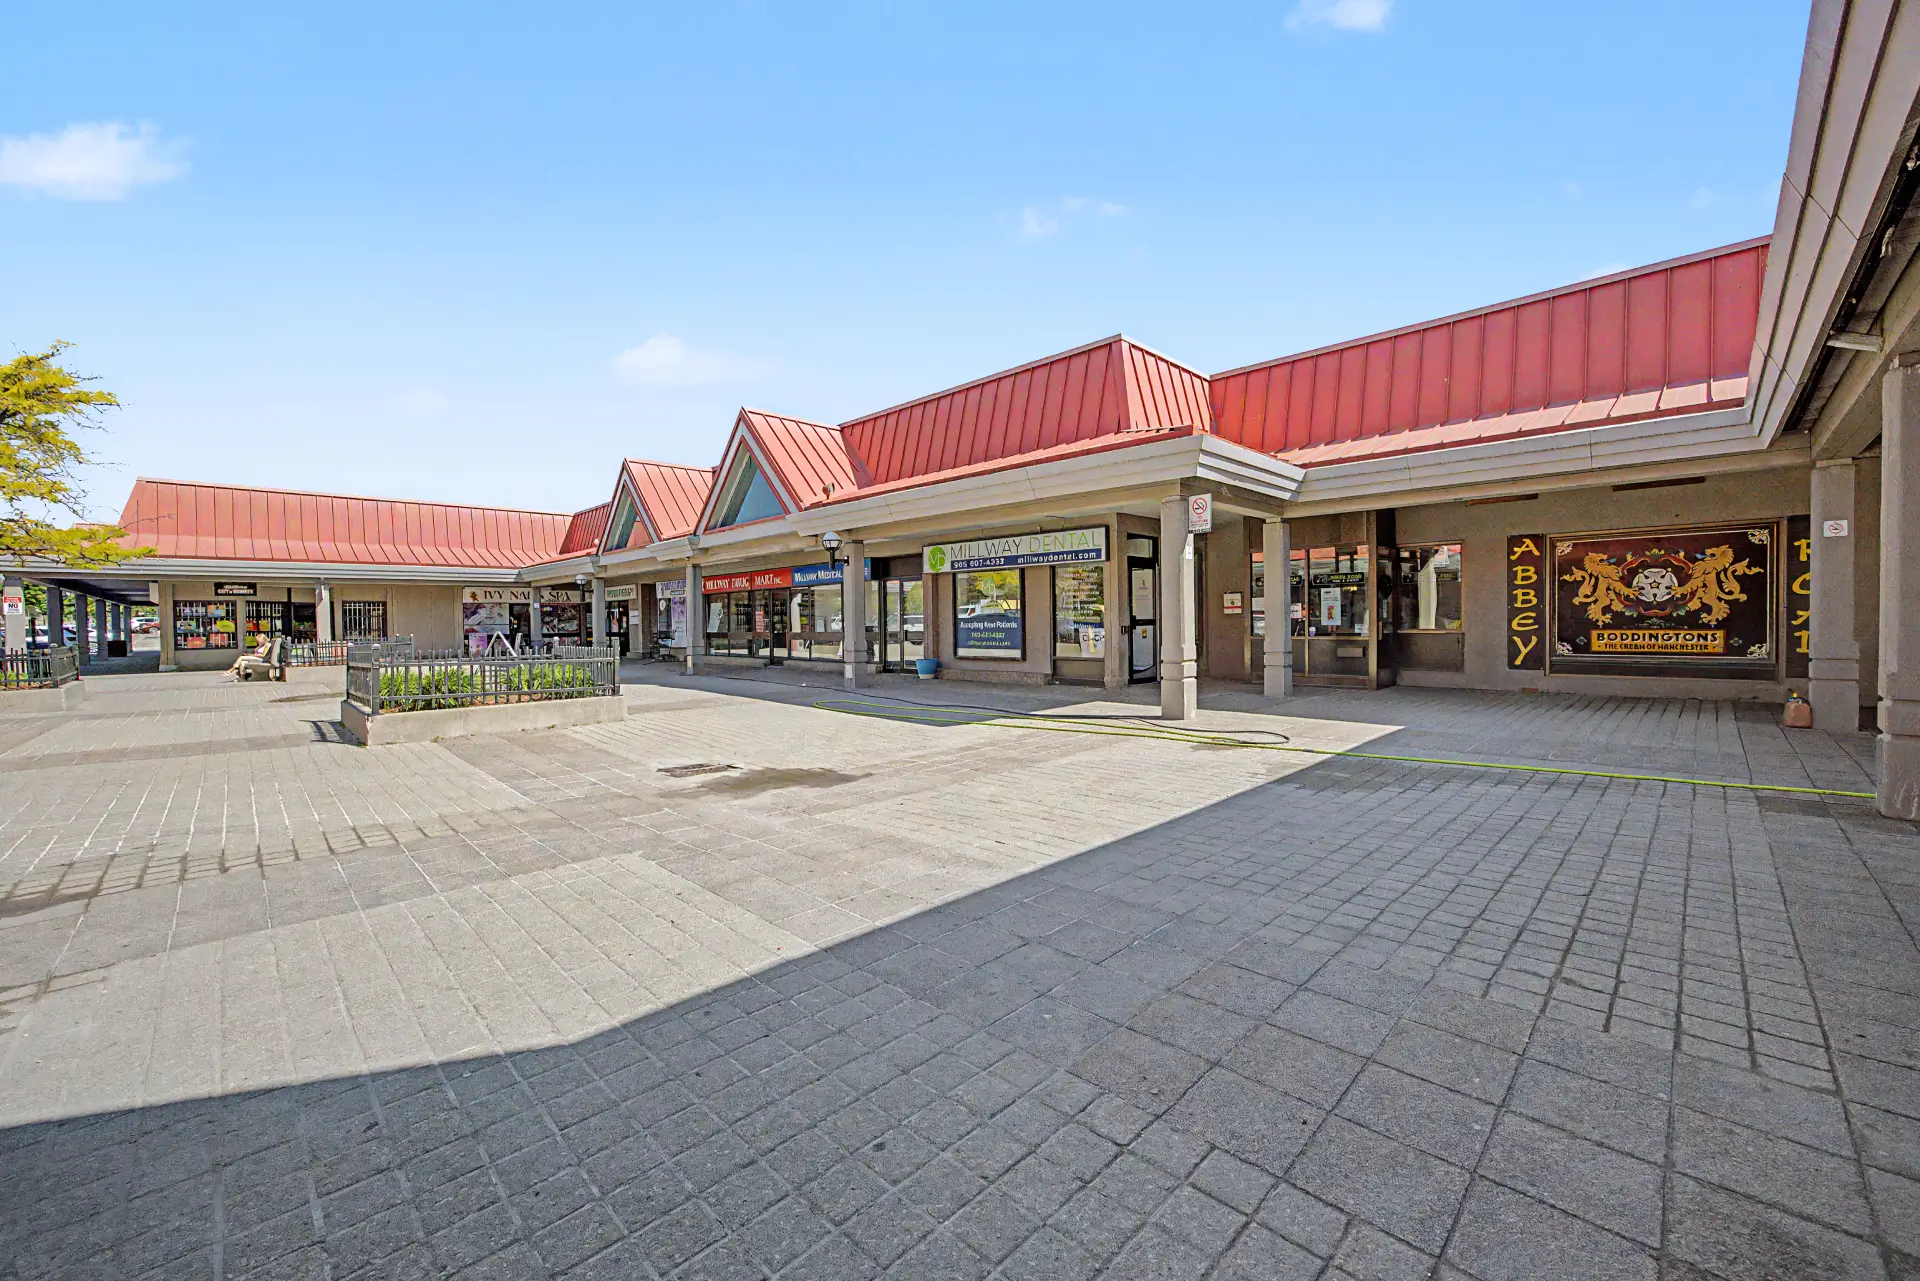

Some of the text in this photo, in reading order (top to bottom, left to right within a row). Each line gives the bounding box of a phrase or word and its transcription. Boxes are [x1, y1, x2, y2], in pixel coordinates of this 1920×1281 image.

[951, 531, 1100, 559] MILLWAY DENTAL
[1017, 551, 1097, 565] millwaydental.com
[706, 578, 729, 590] MILLWAY
[731, 576, 750, 588] DRUG
[754, 573, 774, 586] MART
[795, 570, 843, 582] MILLWAY MEDICAL
[484, 590, 571, 601] IVY NAIS SPA
[1510, 538, 1541, 665] ABBEY
[960, 621, 984, 629] Accepting
[996, 620, 1018, 629] Patients
[1596, 632, 1719, 644] BODDINGTONS
